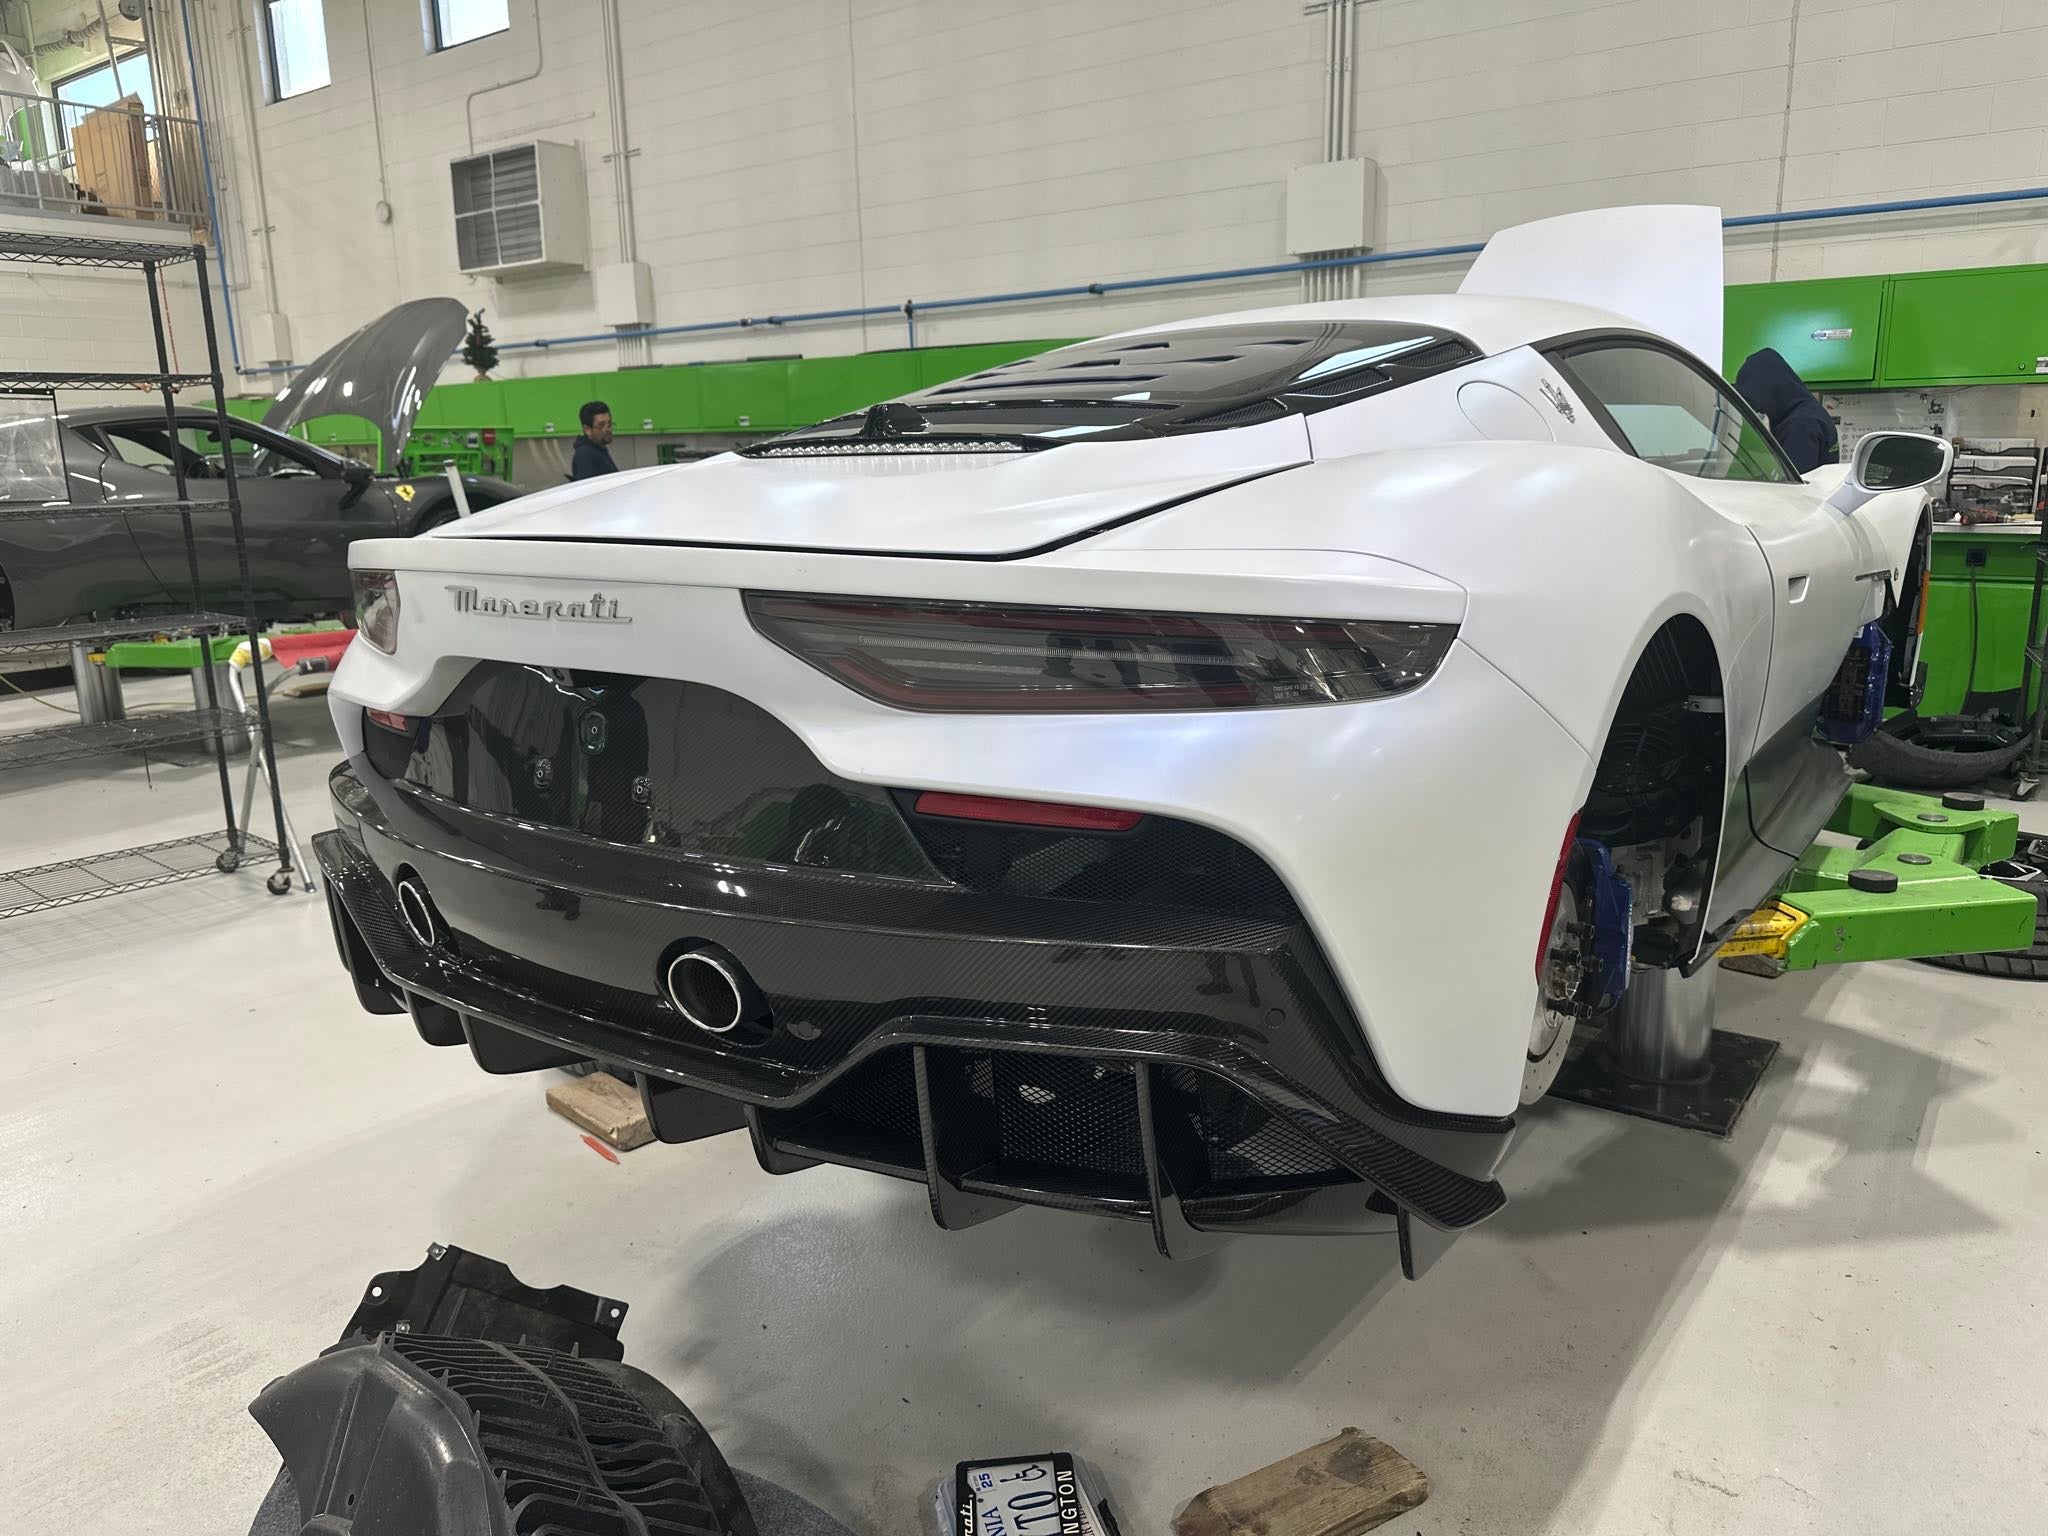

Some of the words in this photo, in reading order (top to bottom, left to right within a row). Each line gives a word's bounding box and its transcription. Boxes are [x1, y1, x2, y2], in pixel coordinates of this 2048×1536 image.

[444, 584, 633, 624] Maserati
[978, 1473, 994, 1489] 25
[1057, 1470, 1080, 1535] NGTON
